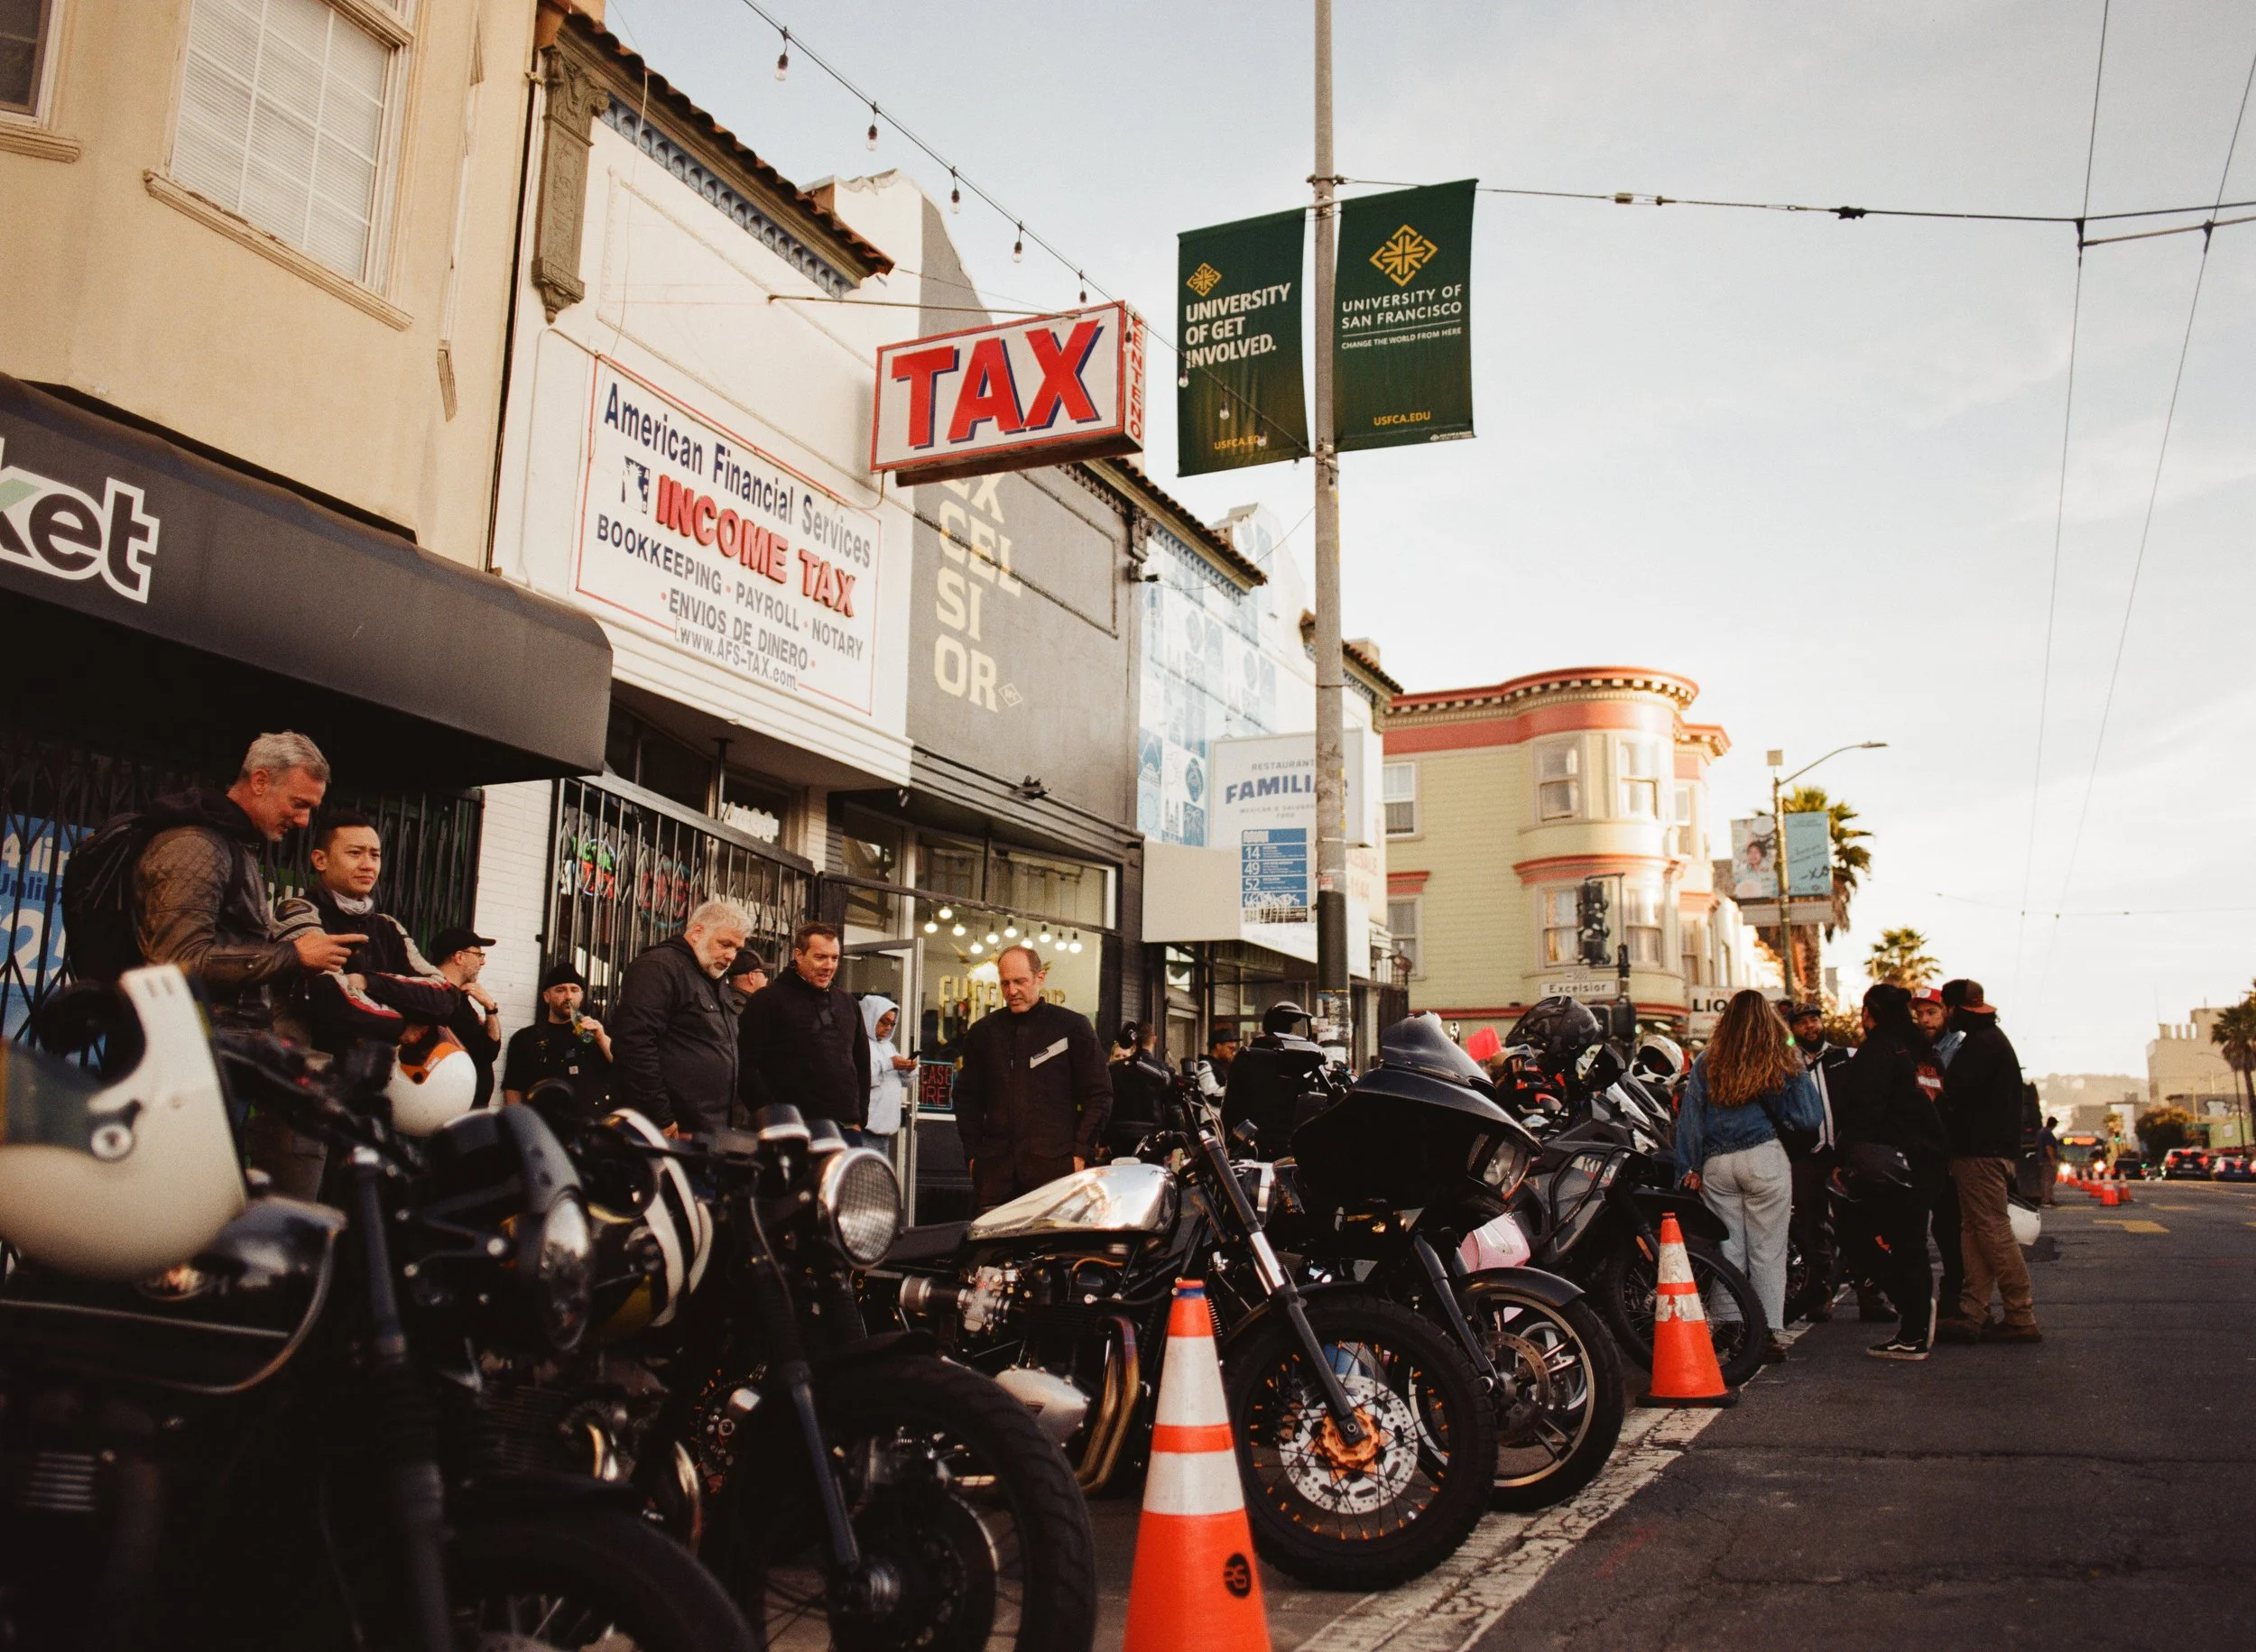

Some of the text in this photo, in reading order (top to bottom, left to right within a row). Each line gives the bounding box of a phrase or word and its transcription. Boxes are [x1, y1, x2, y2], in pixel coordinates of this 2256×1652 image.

[1186, 282, 1291, 323] UNIVERSITY
[1342, 284, 1462, 312] UNIVERSITY OF
[1185, 317, 1246, 346] OF GET
[1341, 301, 1462, 329] SAN FRANCISCO
[1186, 333, 1277, 369] INVOLVED.
[1342, 327, 1462, 350] CHANGE THE WORLD FROM HERE
[891, 318, 1105, 450] TAX
[1373, 411, 1431, 426] USFCA.EDU
[1214, 434, 1268, 450] USFCA.ED
[604, 383, 871, 568] American Financial Services
[655, 475, 856, 617] INCOME TAX
[938, 499, 1022, 598] CEL
[596, 513, 864, 661] BOOKKEEPING PAYROLL NOTARY
[936, 566, 983, 641] SI
[670, 587, 808, 670] ENVIOS DE DINERO
[680, 626, 797, 691] www.AFS-TAX.com
[934, 633, 998, 713] OR
[1225, 774, 1348, 804] FAMILI
[1244, 846, 1261, 859] 14
[1244, 862, 1261, 875] 49
[1244, 878, 1261, 891] 52
[1549, 983, 1606, 993] Excelsior
